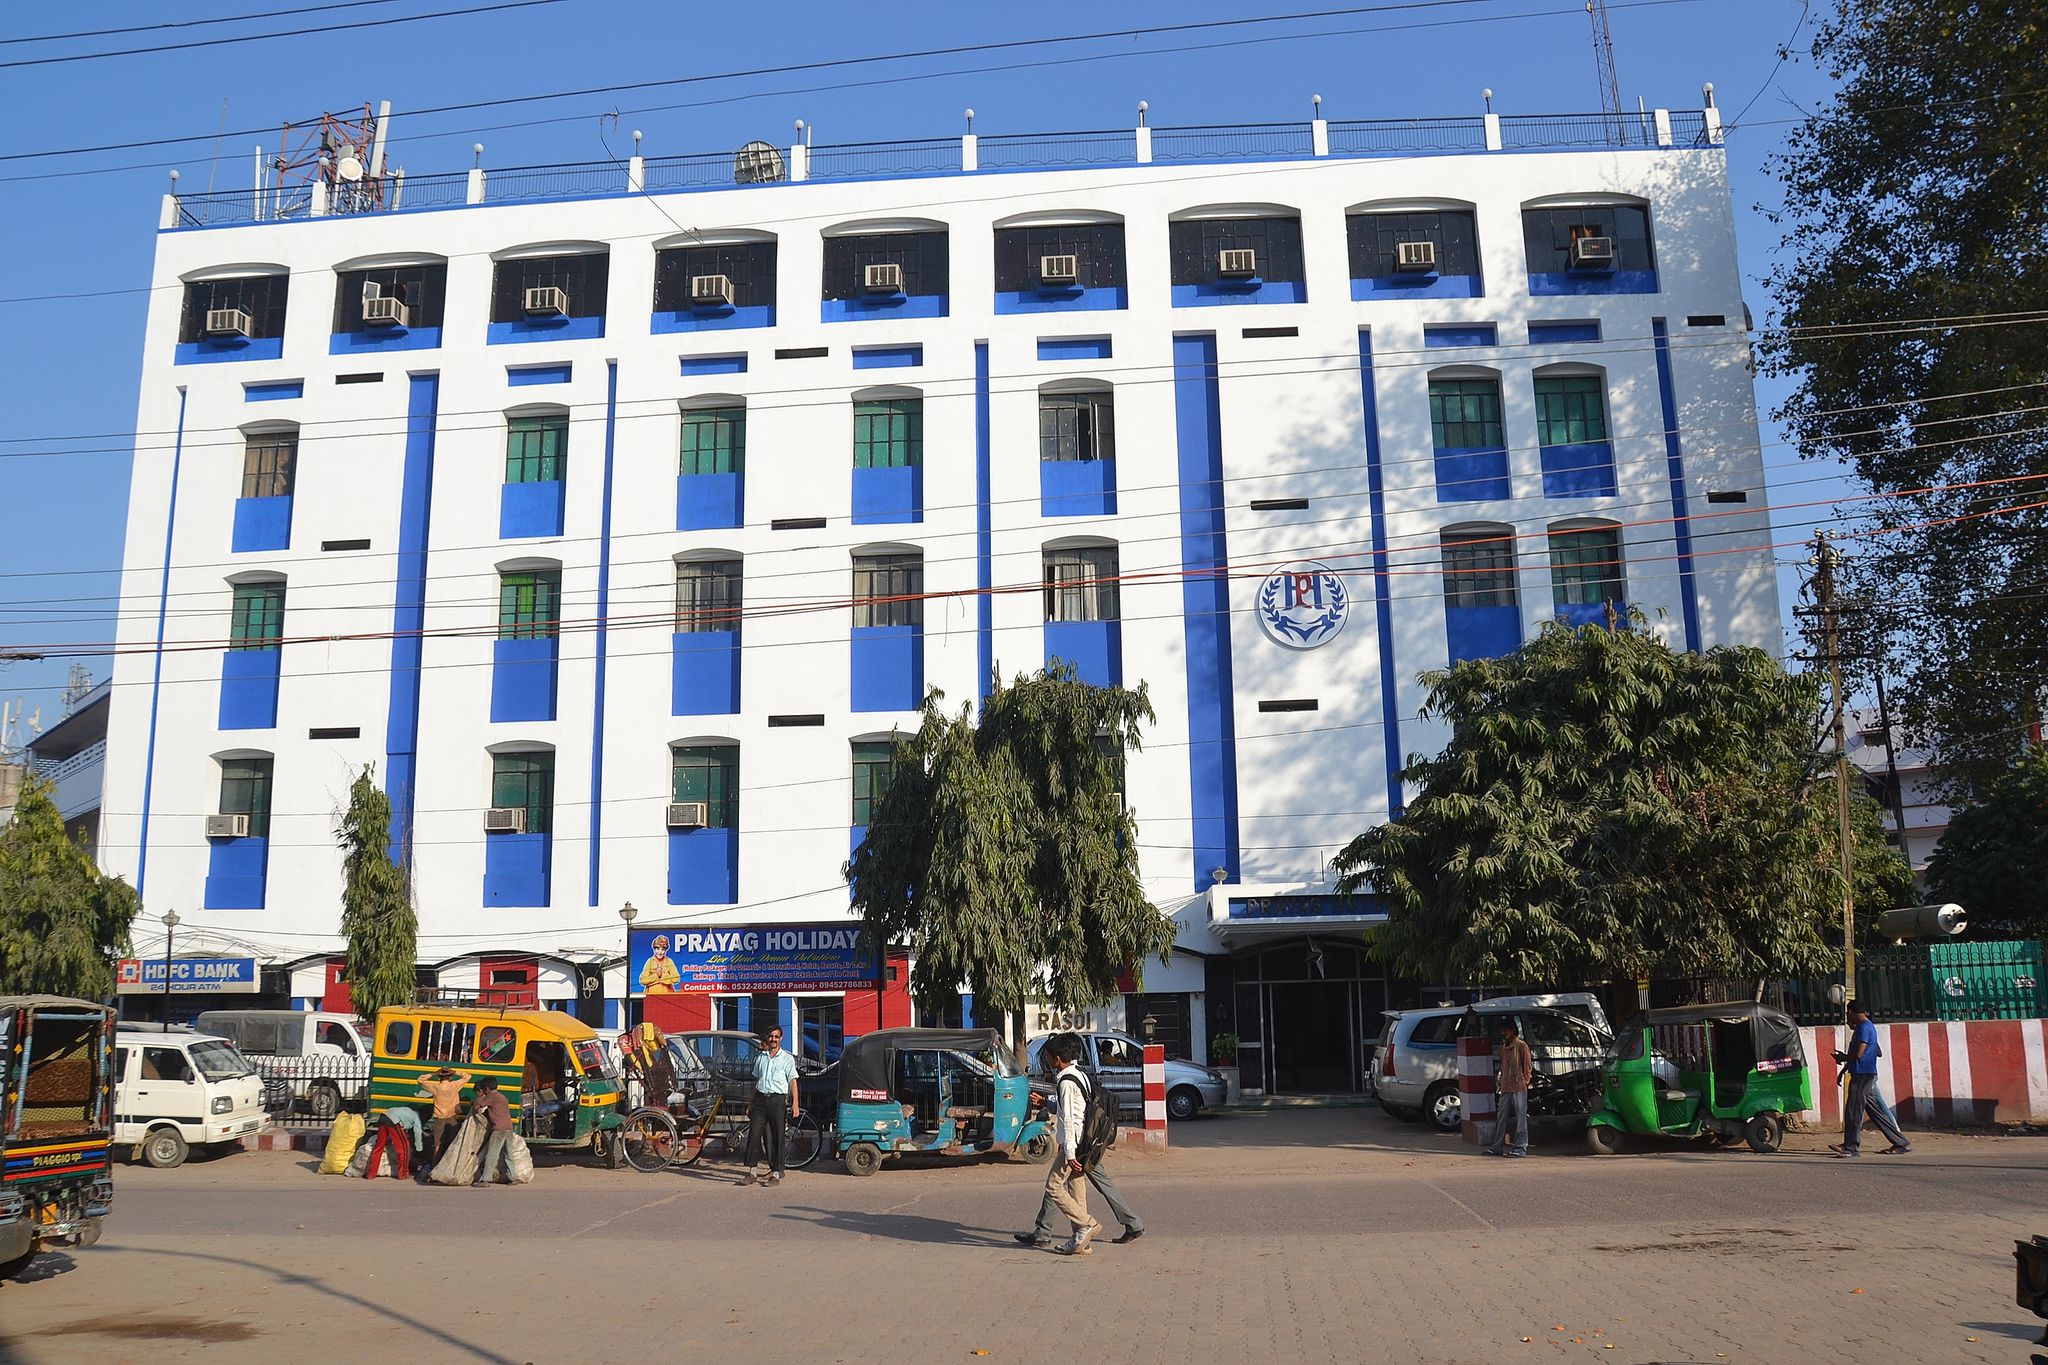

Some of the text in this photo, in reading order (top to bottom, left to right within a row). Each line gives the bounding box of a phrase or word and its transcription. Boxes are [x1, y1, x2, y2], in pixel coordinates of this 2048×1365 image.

[674, 930, 861, 953] PRAYAG HOLIDAY
[730, 953, 756, 964] Your
[144, 963, 240, 979] HDFC BANK
[197, 983, 221, 991] ATM
[684, 983, 715, 991] Contact
[716, 983, 730, 991] No.
[1037, 1011, 1091, 1031] RASOI
[33, 1153, 71, 1167] PIAGGIO
